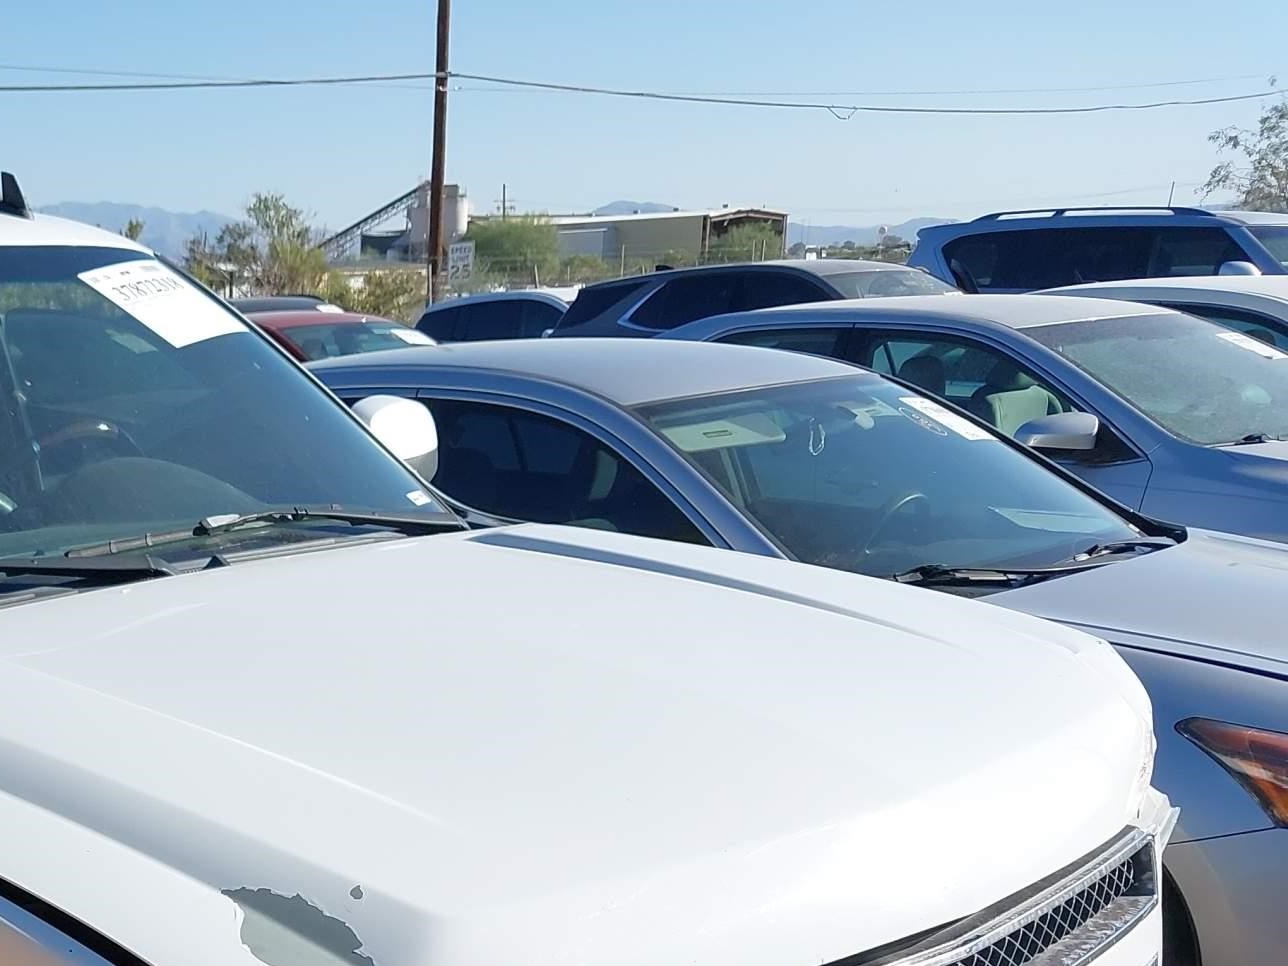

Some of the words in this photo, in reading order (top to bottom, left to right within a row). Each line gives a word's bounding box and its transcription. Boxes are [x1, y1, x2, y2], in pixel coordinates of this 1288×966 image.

[450, 245, 472, 255] SPEED
[450, 263, 471, 281] 25
[111, 275, 185, 301] 37872318
